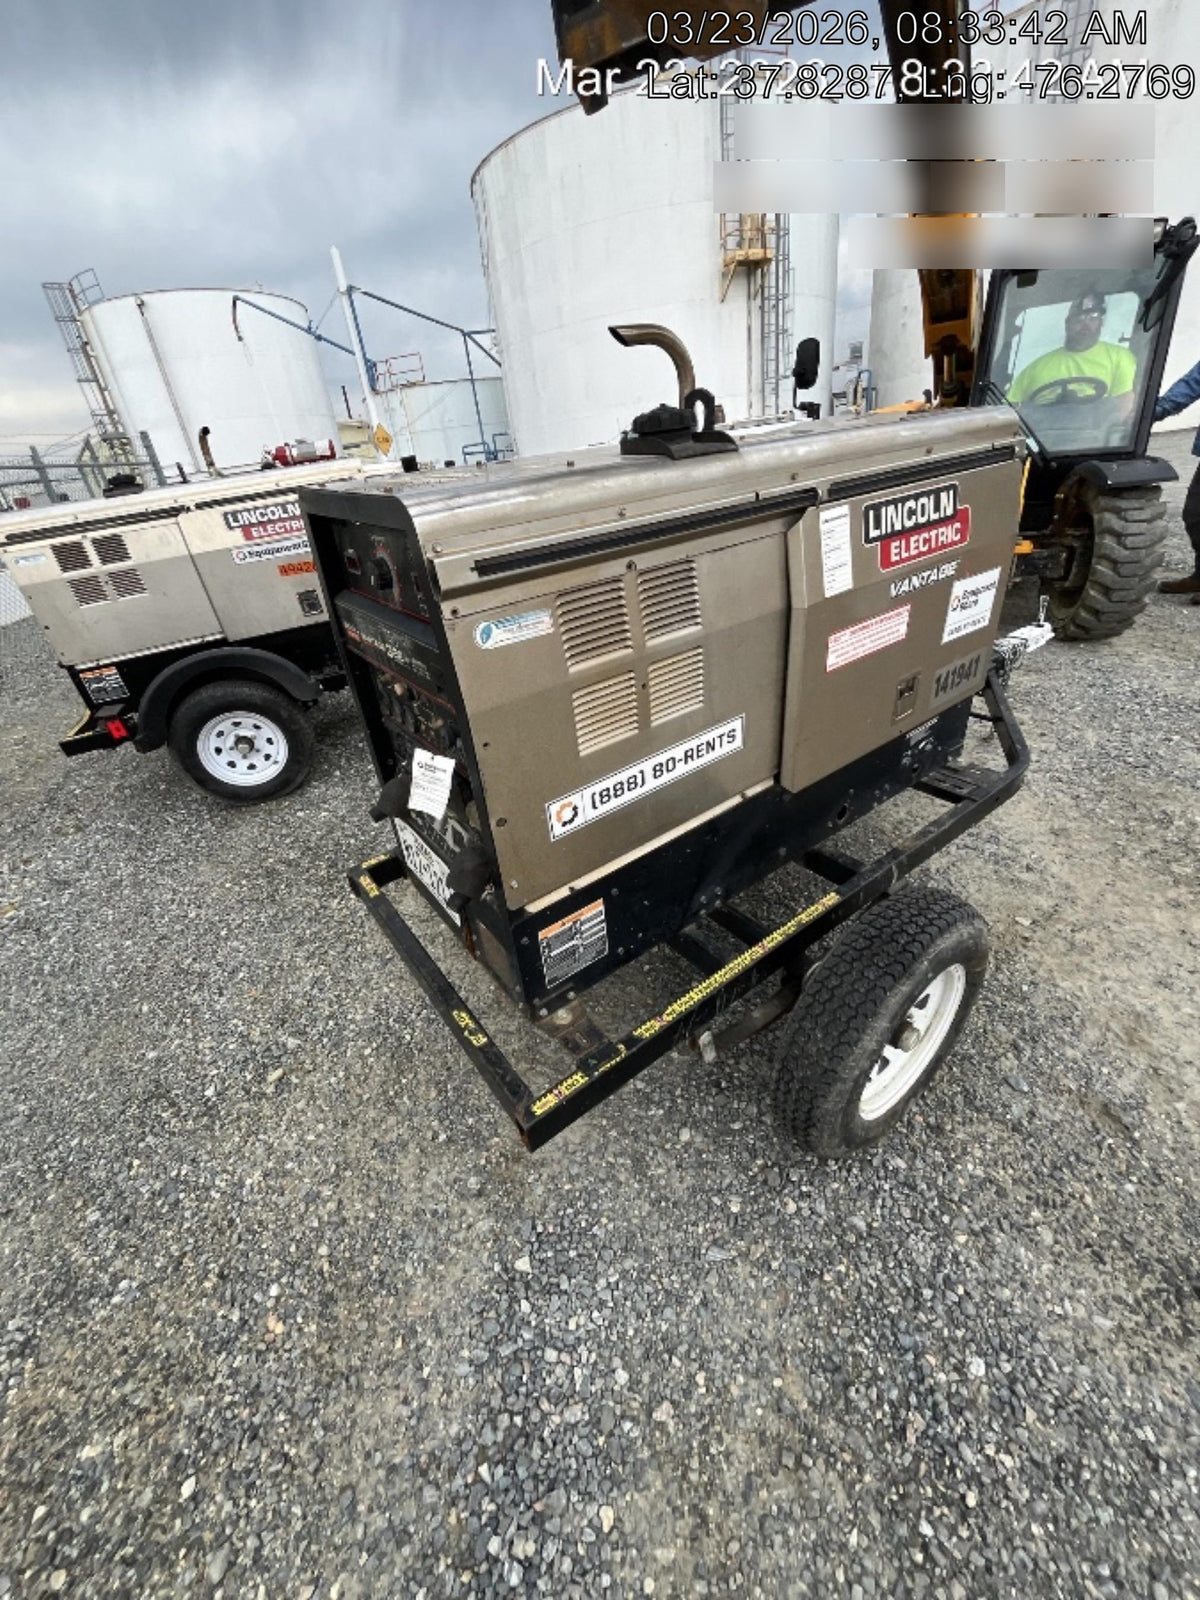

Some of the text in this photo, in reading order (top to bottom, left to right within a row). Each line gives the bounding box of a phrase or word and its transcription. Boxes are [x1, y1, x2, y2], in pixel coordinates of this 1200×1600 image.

[227, 502, 301, 527] LINCOLN
[250, 518, 305, 538] ELECTRI
[869, 489, 955, 540] LINCOLN
[889, 521, 962, 563] ELECTRIC
[890, 559, 961, 599] VANTAGE
[591, 728, 738, 811] (888) 80-RENTS
